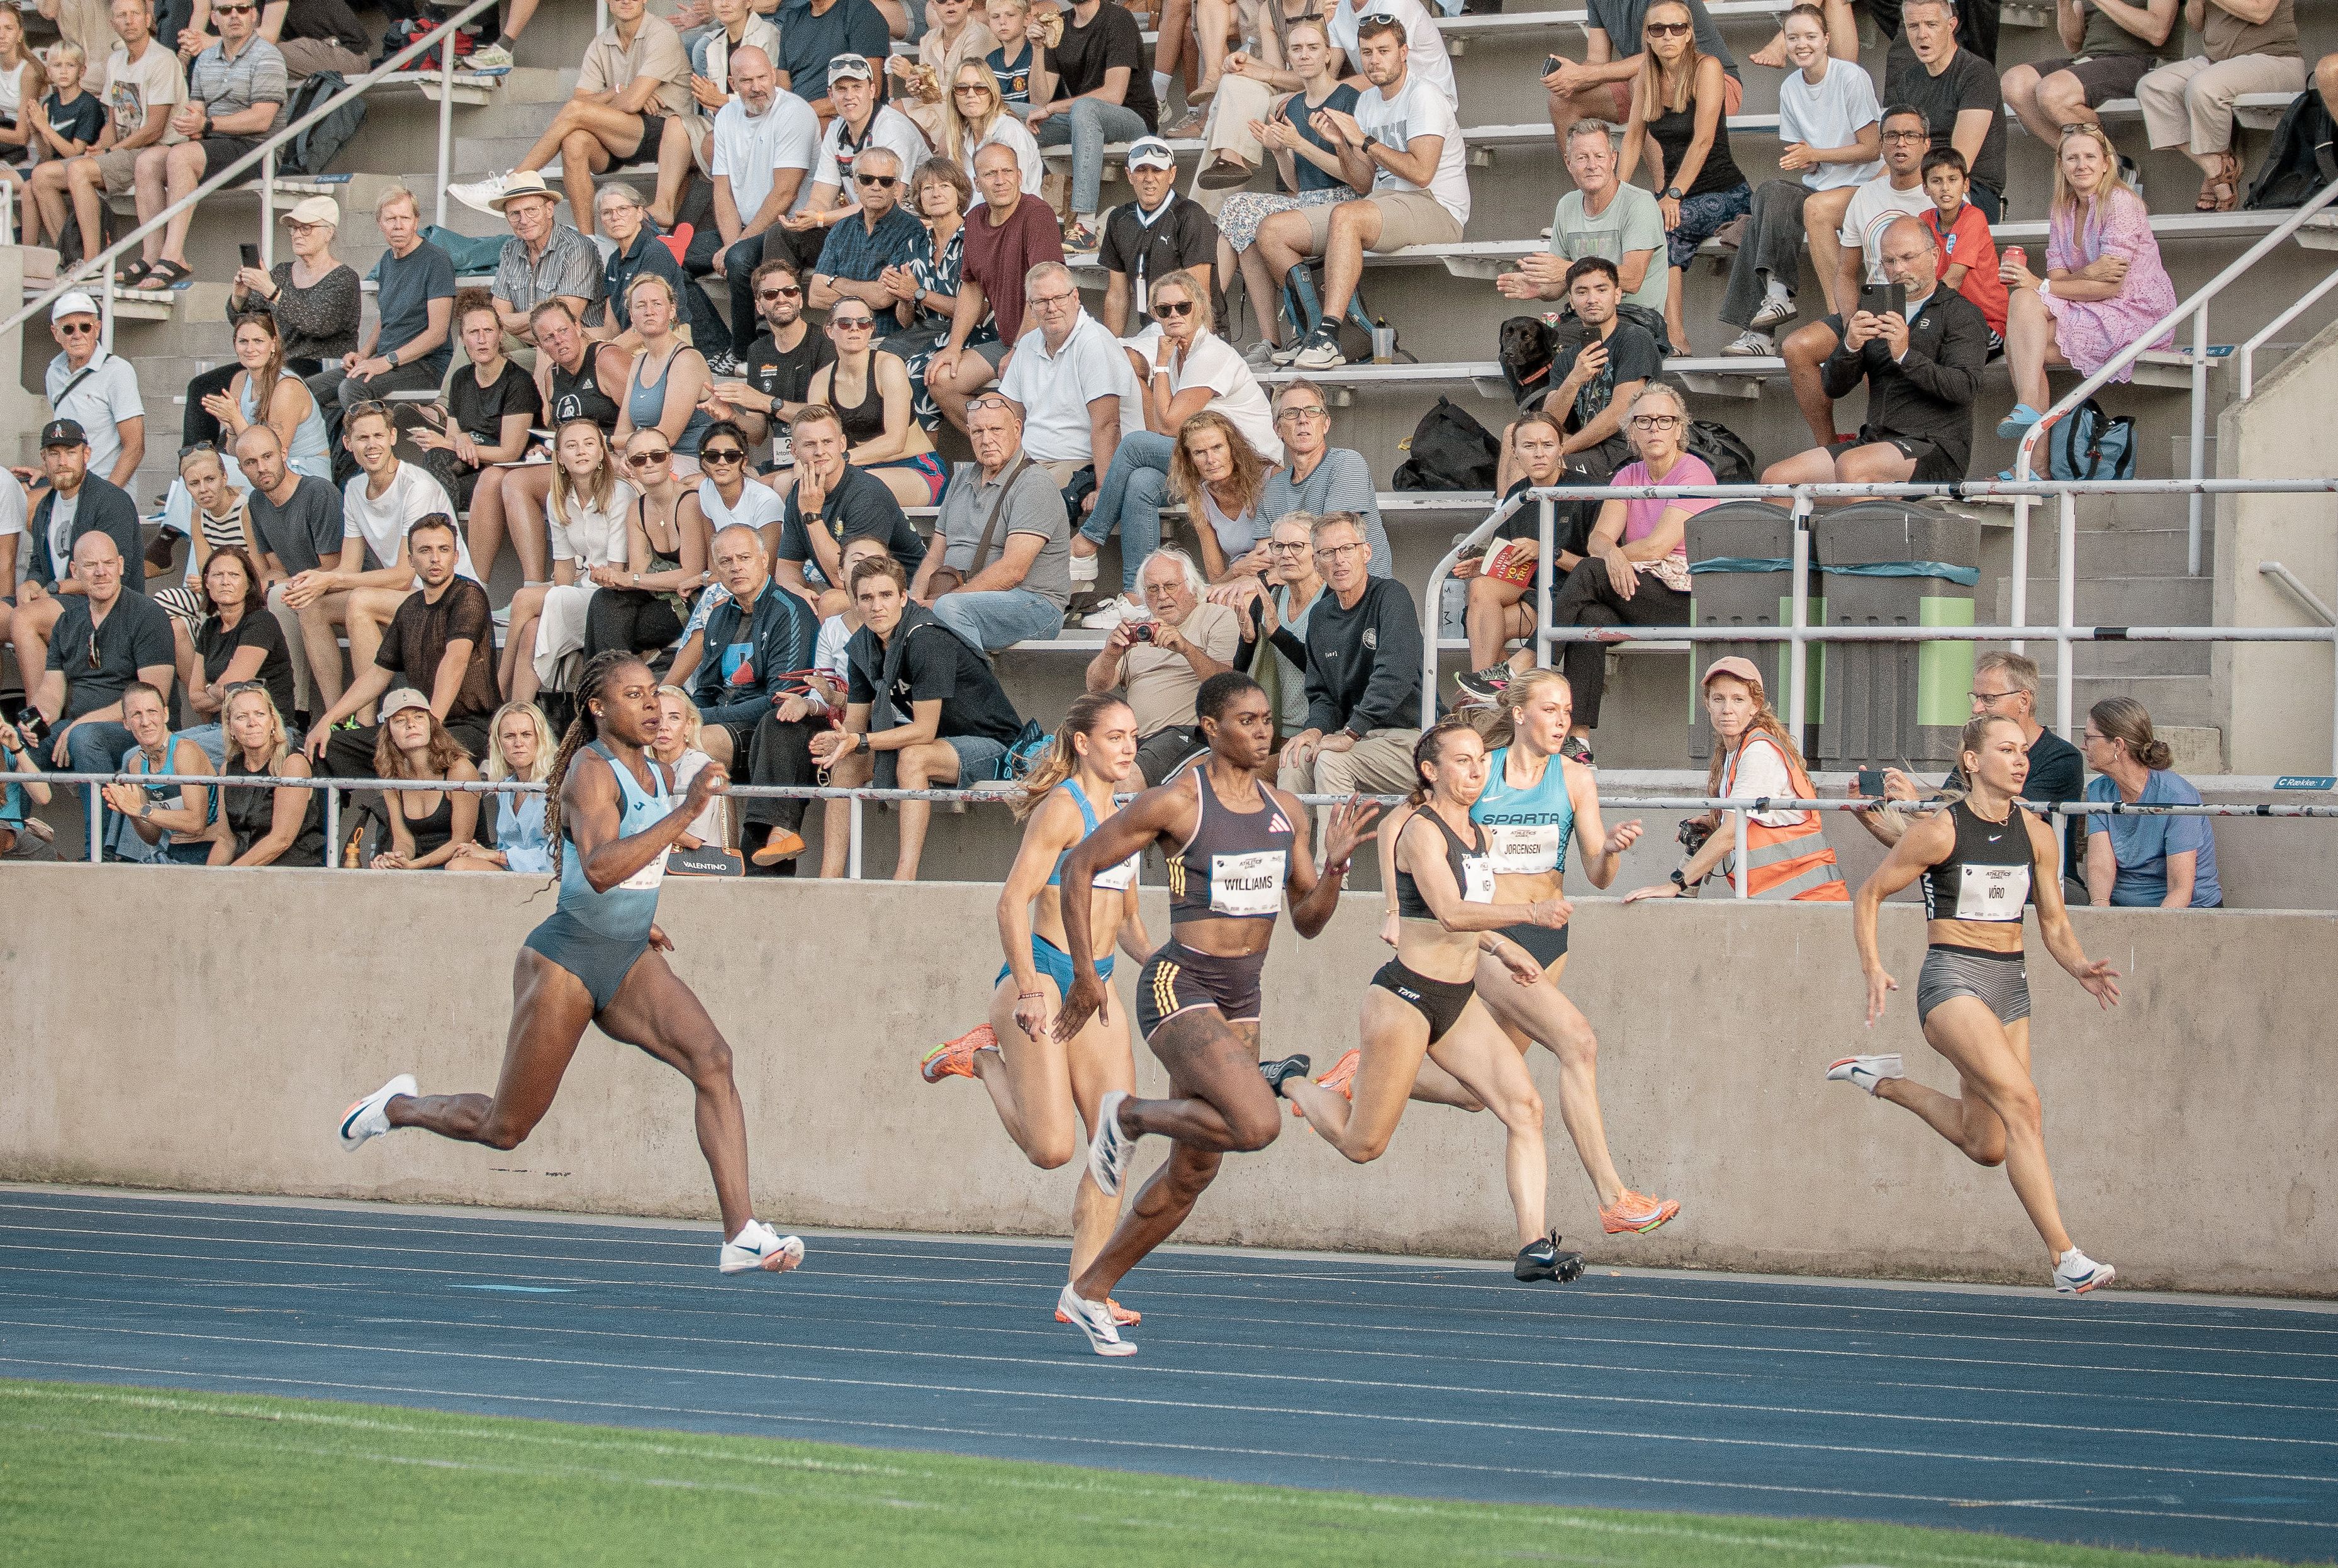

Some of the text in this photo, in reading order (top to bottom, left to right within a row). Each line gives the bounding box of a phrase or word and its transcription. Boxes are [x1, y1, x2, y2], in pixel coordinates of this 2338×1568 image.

[1482, 813, 1559, 824] SPARTA
[683, 861, 727, 871] VALENTINO
[1224, 875, 1273, 891] WILLIAMS
